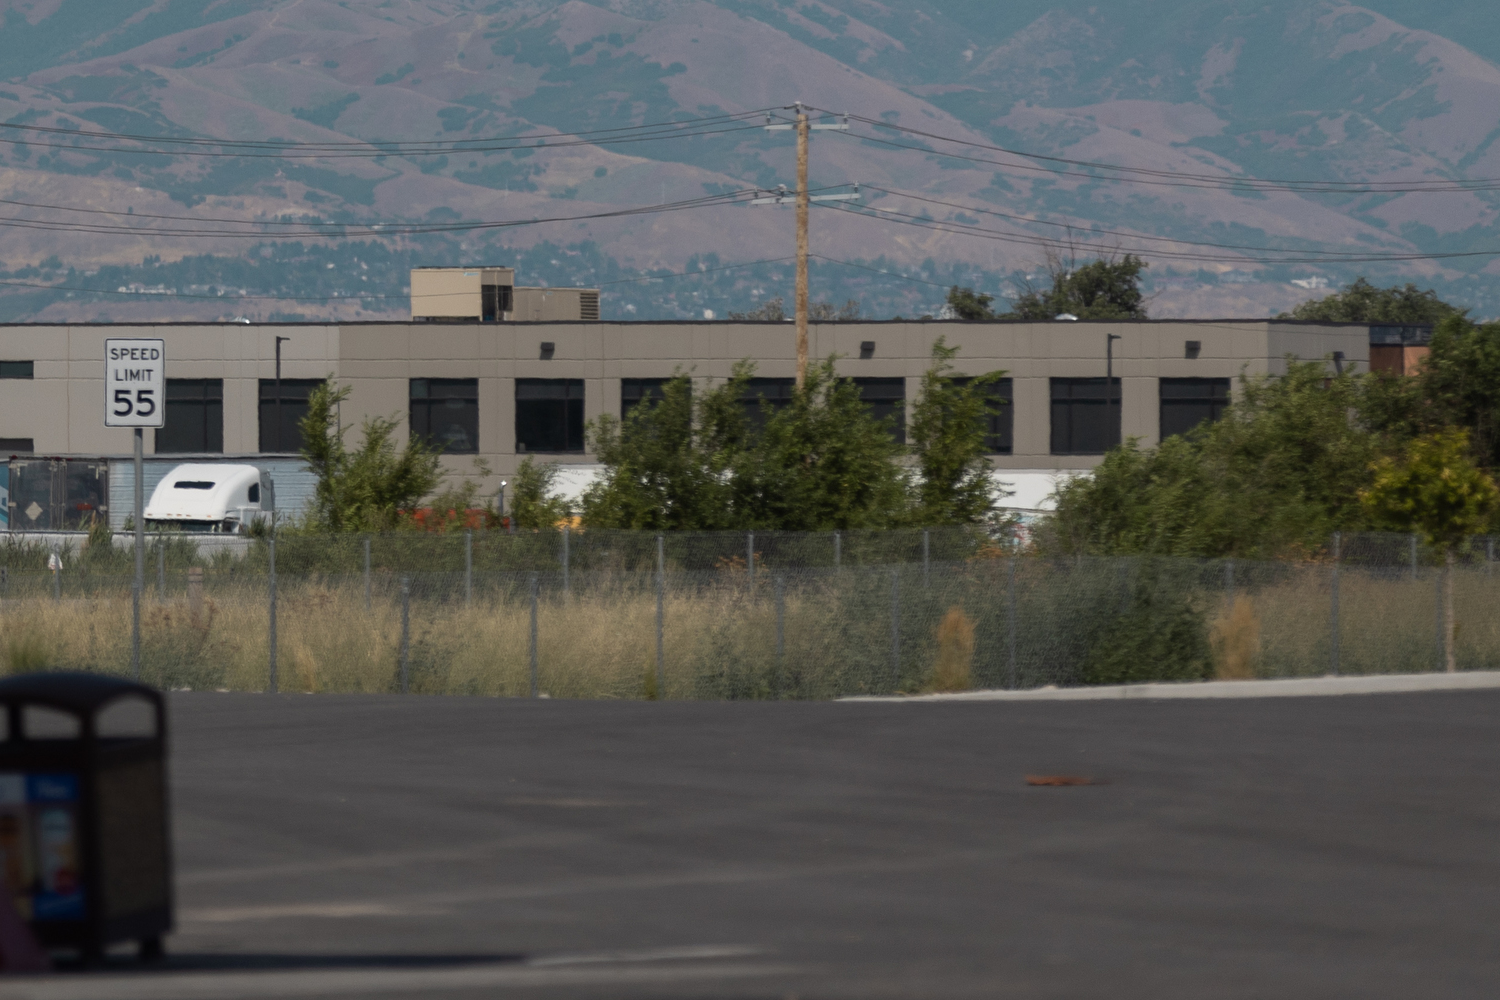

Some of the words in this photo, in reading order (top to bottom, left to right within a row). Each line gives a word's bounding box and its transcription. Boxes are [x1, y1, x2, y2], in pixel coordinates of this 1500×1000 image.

[110, 347, 160, 361] SPEED
[114, 368, 154, 382] LIMIT
[113, 389, 156, 417] 55
